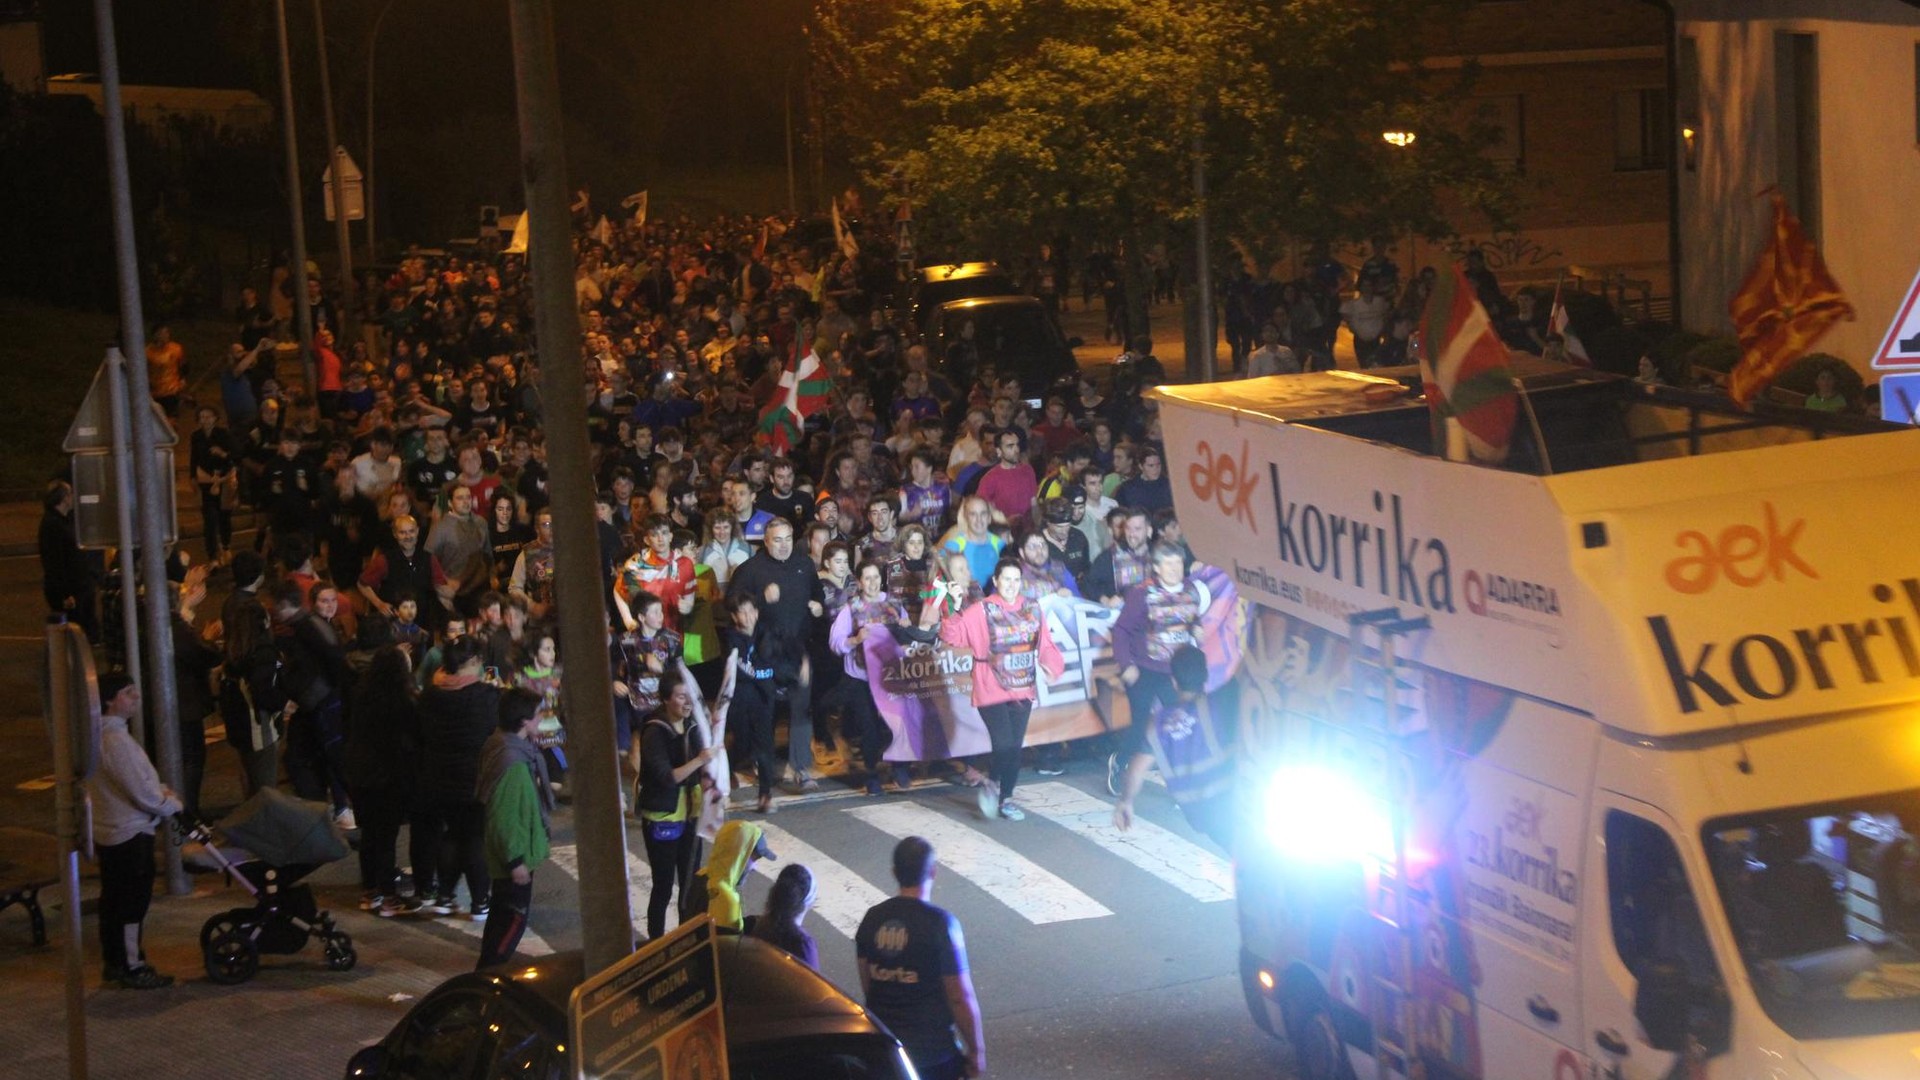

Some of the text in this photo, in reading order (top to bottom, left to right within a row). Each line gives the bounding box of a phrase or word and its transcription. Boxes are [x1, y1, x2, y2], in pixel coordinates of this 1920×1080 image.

[1188, 440, 1260, 535] aek
[1268, 461, 1456, 614] korrika
[1663, 501, 1820, 594] aek
[1486, 573, 1562, 616] ADARRA
